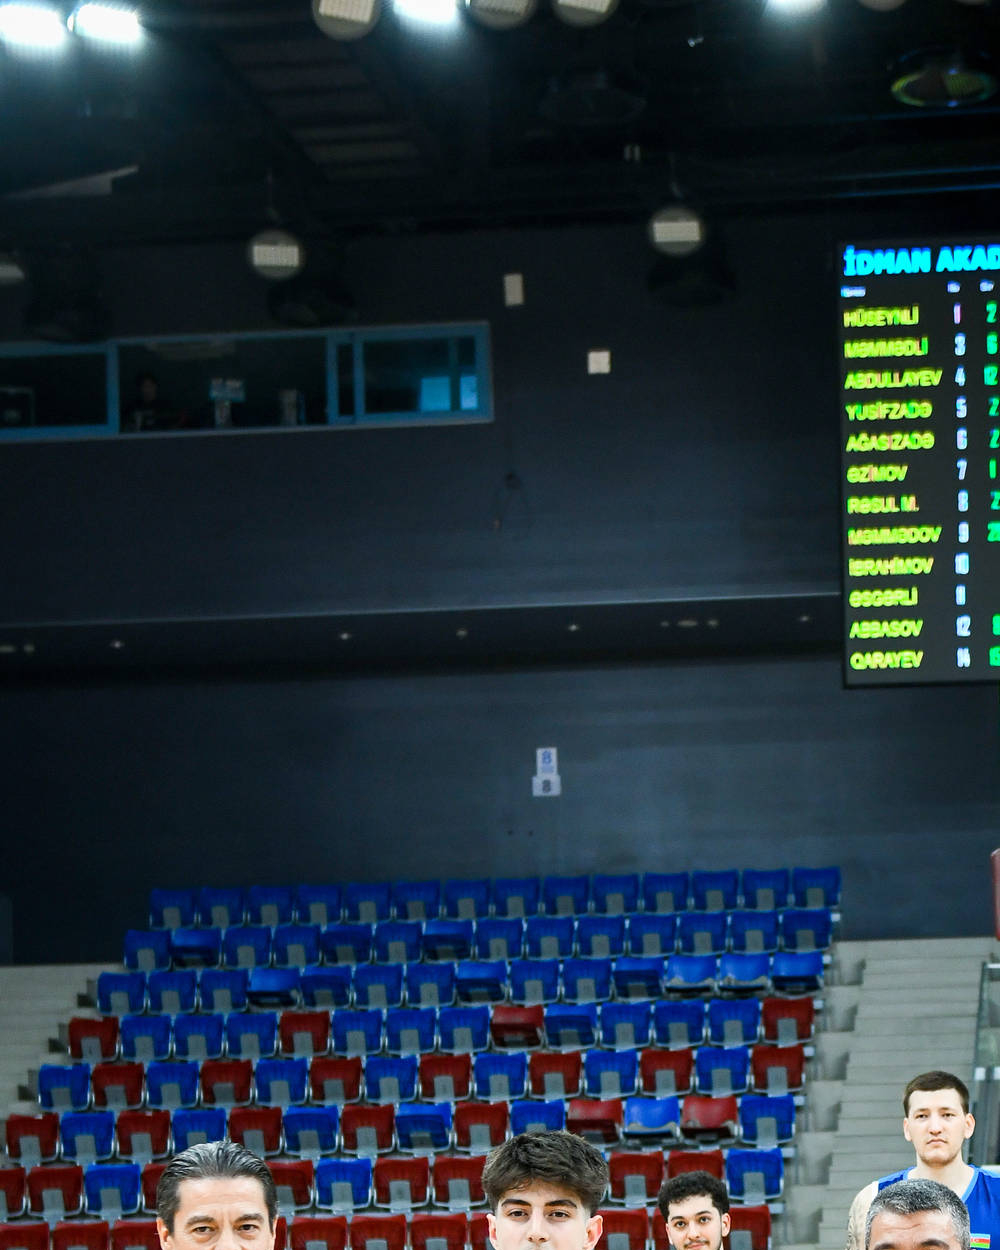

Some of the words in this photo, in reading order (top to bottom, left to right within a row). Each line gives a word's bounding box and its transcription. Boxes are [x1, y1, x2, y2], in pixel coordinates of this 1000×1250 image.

[843, 245, 932, 276] İDMAN
[953, 302, 961, 325] 1
[986, 301, 998, 324] 2
[955, 364, 966, 387] 4
[956, 395, 968, 419] 5
[989, 396, 1000, 417] 2
[989, 428, 1000, 448] 2
[957, 457, 968, 481] 7
[988, 458, 997, 479] 1
[850, 649, 924, 671] QARAYEV
